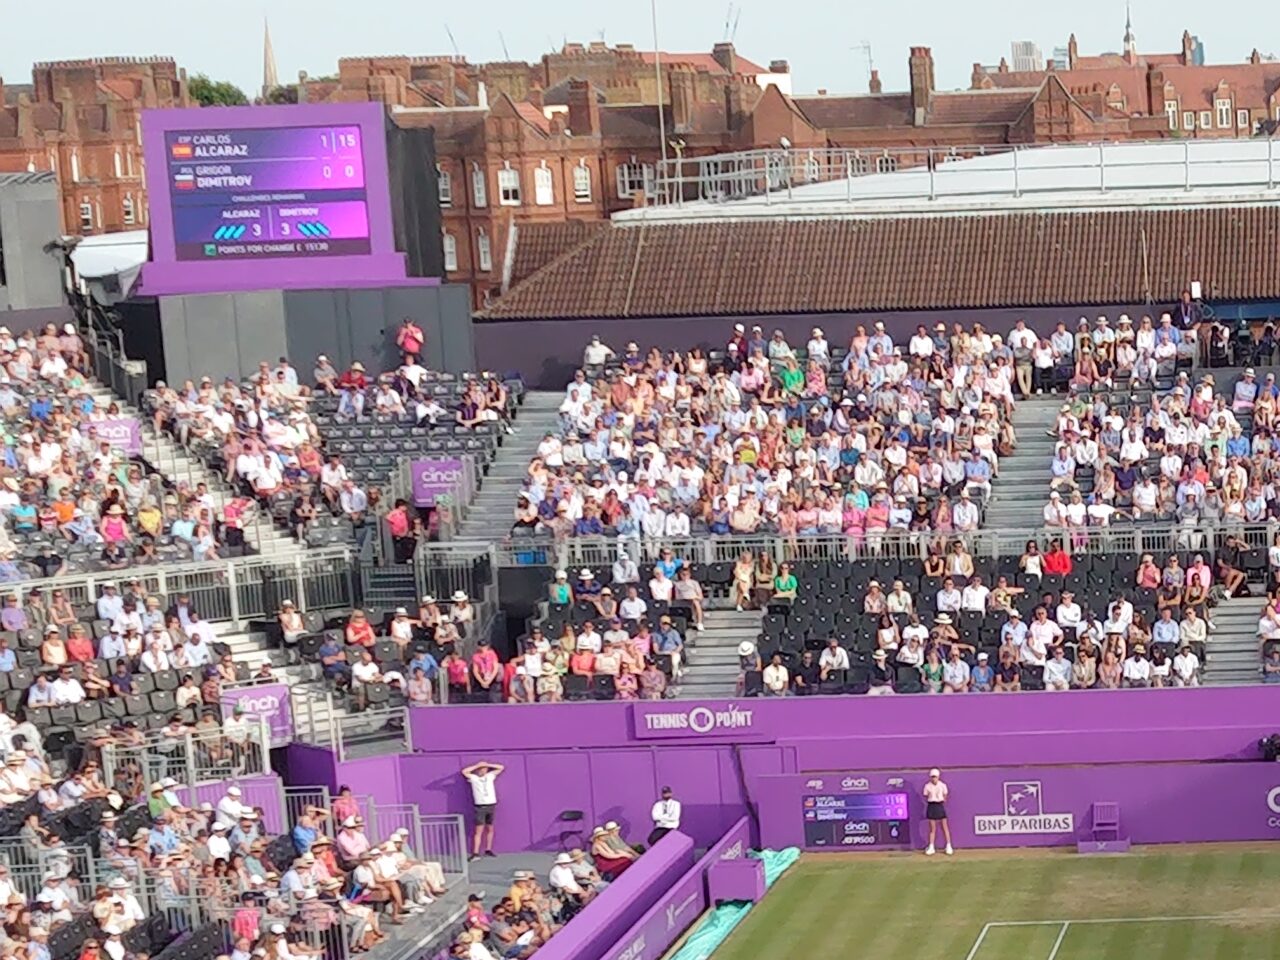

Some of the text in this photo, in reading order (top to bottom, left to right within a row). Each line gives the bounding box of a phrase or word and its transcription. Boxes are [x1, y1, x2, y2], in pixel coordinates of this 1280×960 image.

[193, 134, 231, 144] CARLOS
[339, 134, 356, 147] 15
[194, 145, 248, 157] ALCARAZ
[196, 165, 232, 175] GRIGOR
[323, 165, 355, 178] 0 0
[196, 175, 252, 188] DIMITROV
[222, 209, 260, 218] ALCARAZ
[279, 207, 319, 217] DIMITROV
[252, 223, 262, 236] 3
[281, 222, 290, 235] 3
[218, 245, 246, 253] POINTS
[247, 244, 263, 252] FOR
[421, 466, 462, 481] cinch
[645, 713, 689, 729] TENNIS
[841, 777, 868, 787] cinch
[977, 817, 1070, 831] BNP PARIBAS
